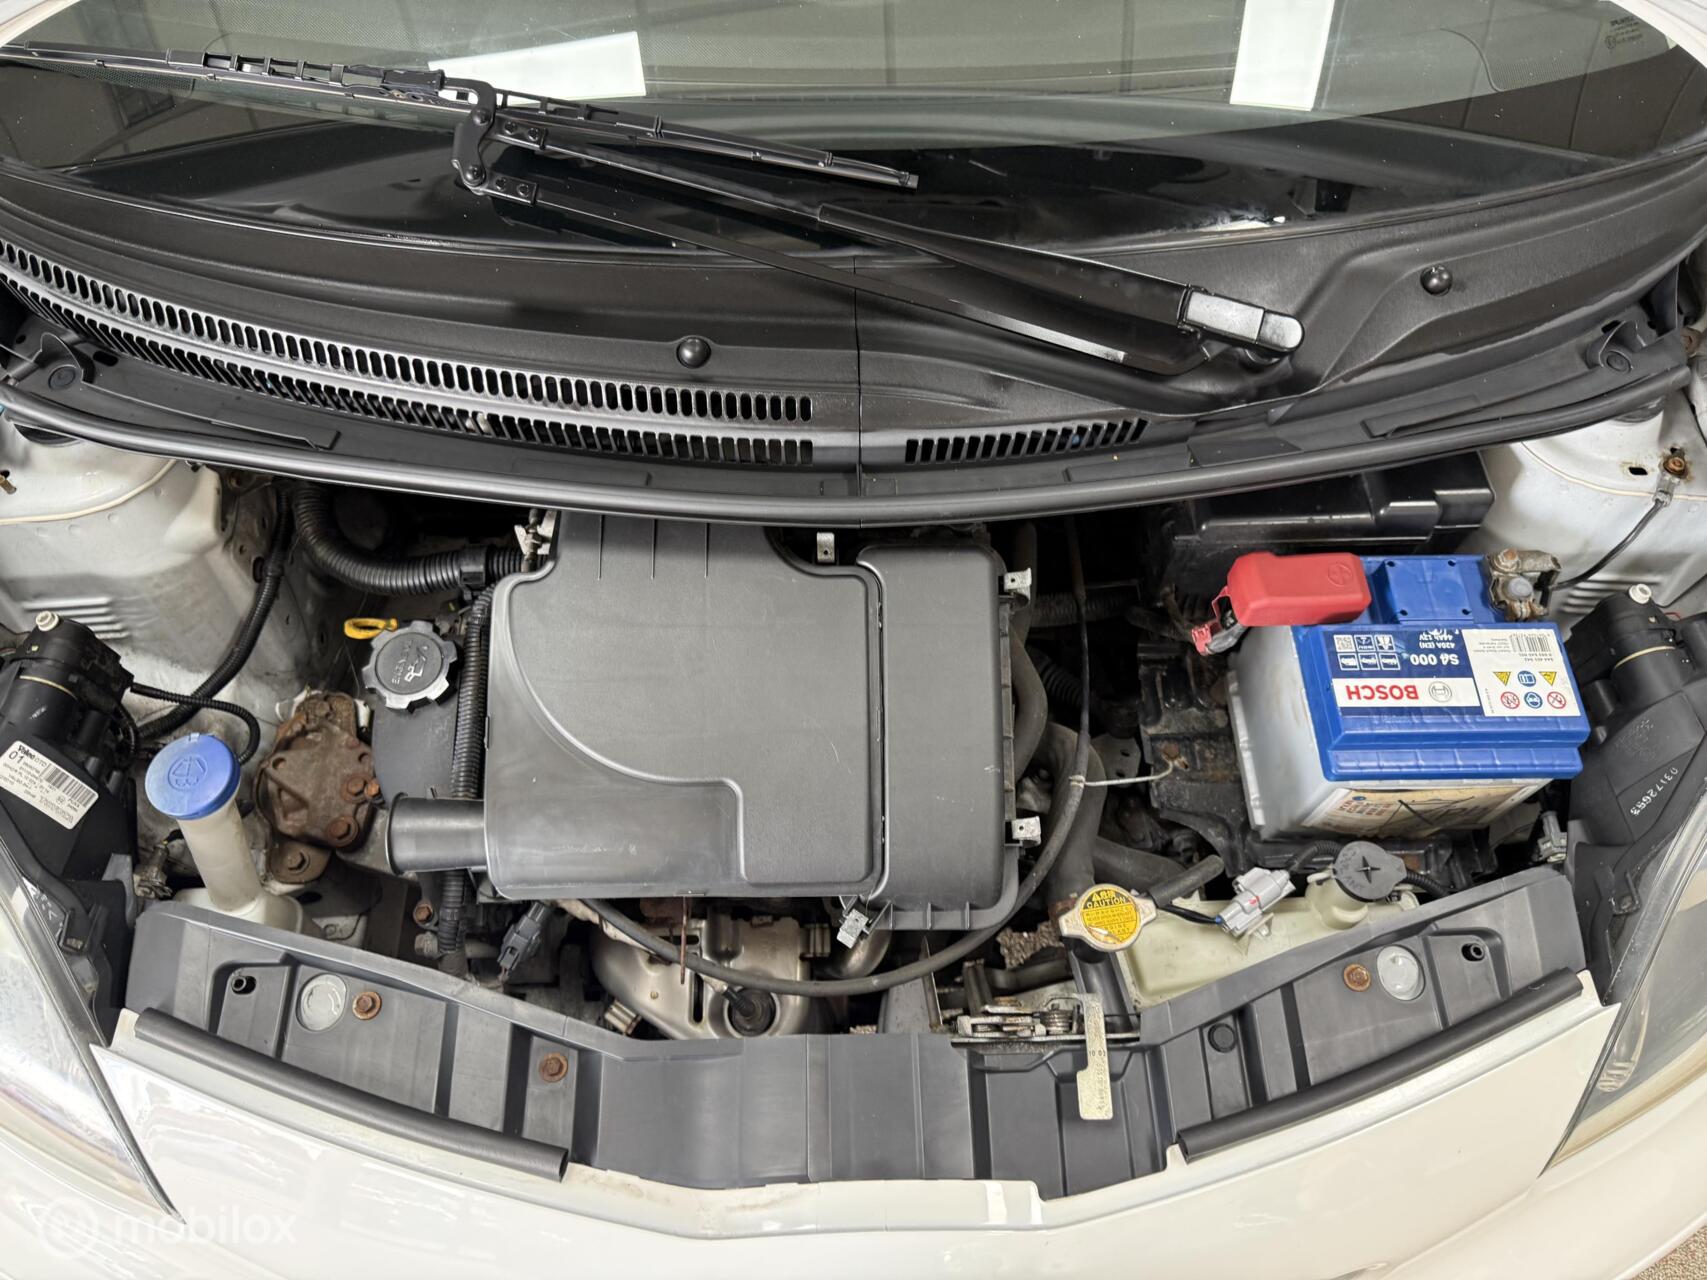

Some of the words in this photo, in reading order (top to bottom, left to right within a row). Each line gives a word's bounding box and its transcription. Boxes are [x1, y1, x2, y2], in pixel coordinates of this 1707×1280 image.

[1409, 653, 1438, 666] 000
[1439, 652, 1460, 666] S4
[1345, 684, 1420, 700] BOSCH
[8, 750, 24, 764] 01
[1086, 896, 1126, 909] CAUTION
